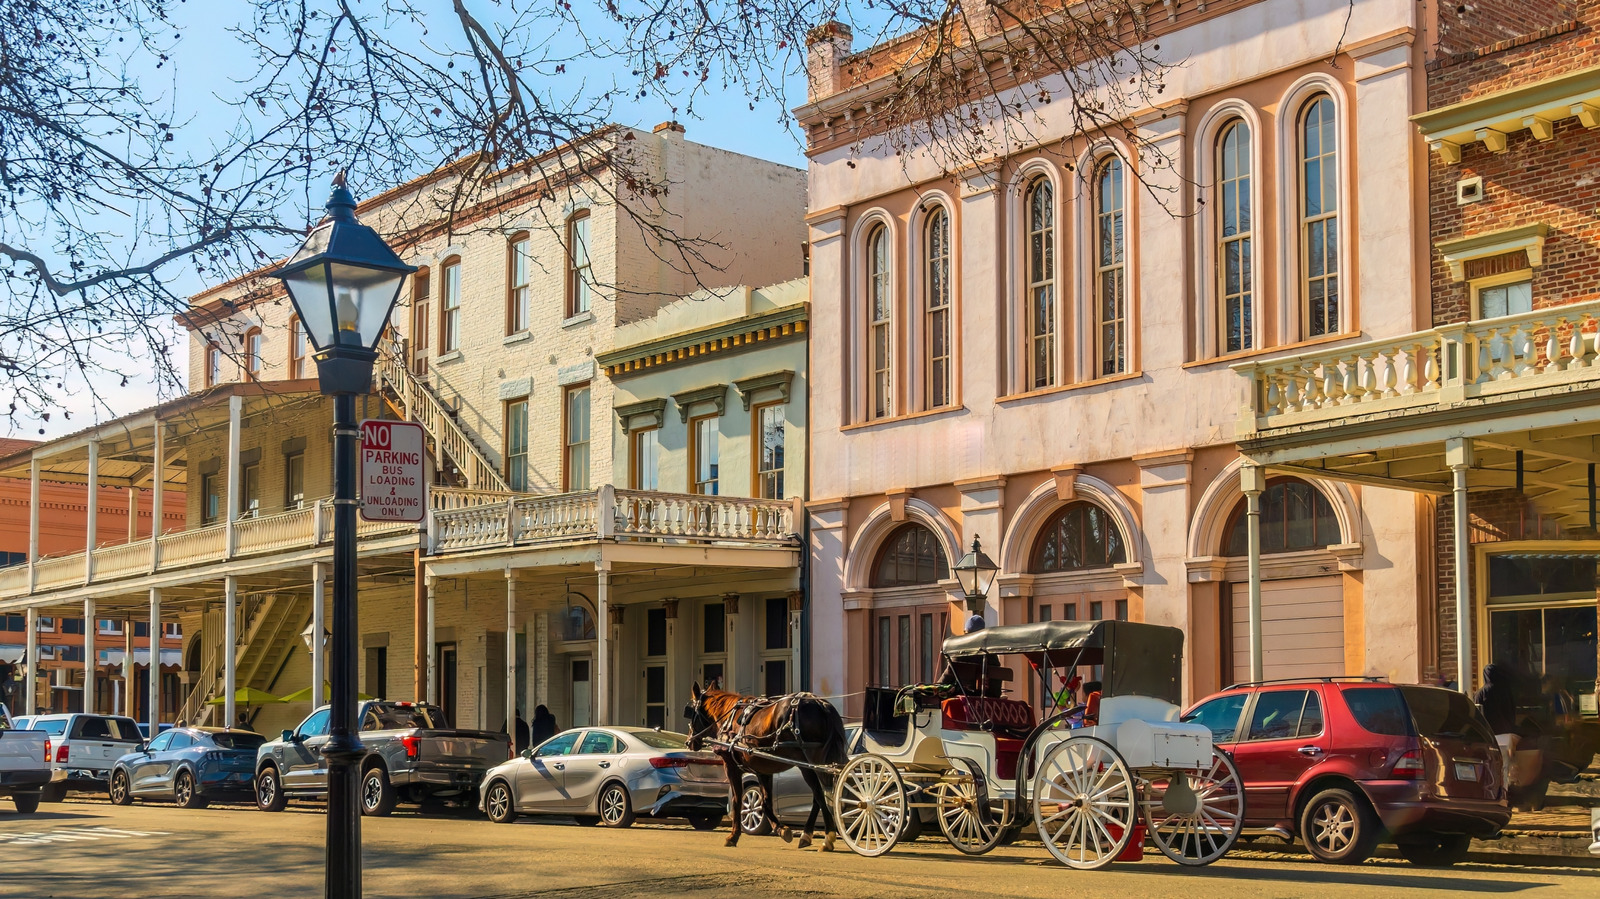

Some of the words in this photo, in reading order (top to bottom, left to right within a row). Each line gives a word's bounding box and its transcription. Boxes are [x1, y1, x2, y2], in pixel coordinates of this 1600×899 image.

[365, 425, 389, 446] NO
[366, 451, 419, 465] PARKING
[382, 466, 403, 475] BUS
[370, 475, 415, 486] LOADING
[390, 487, 396, 495] &
[367, 496, 418, 506] UNLOADING
[382, 508, 405, 516] ONLY
